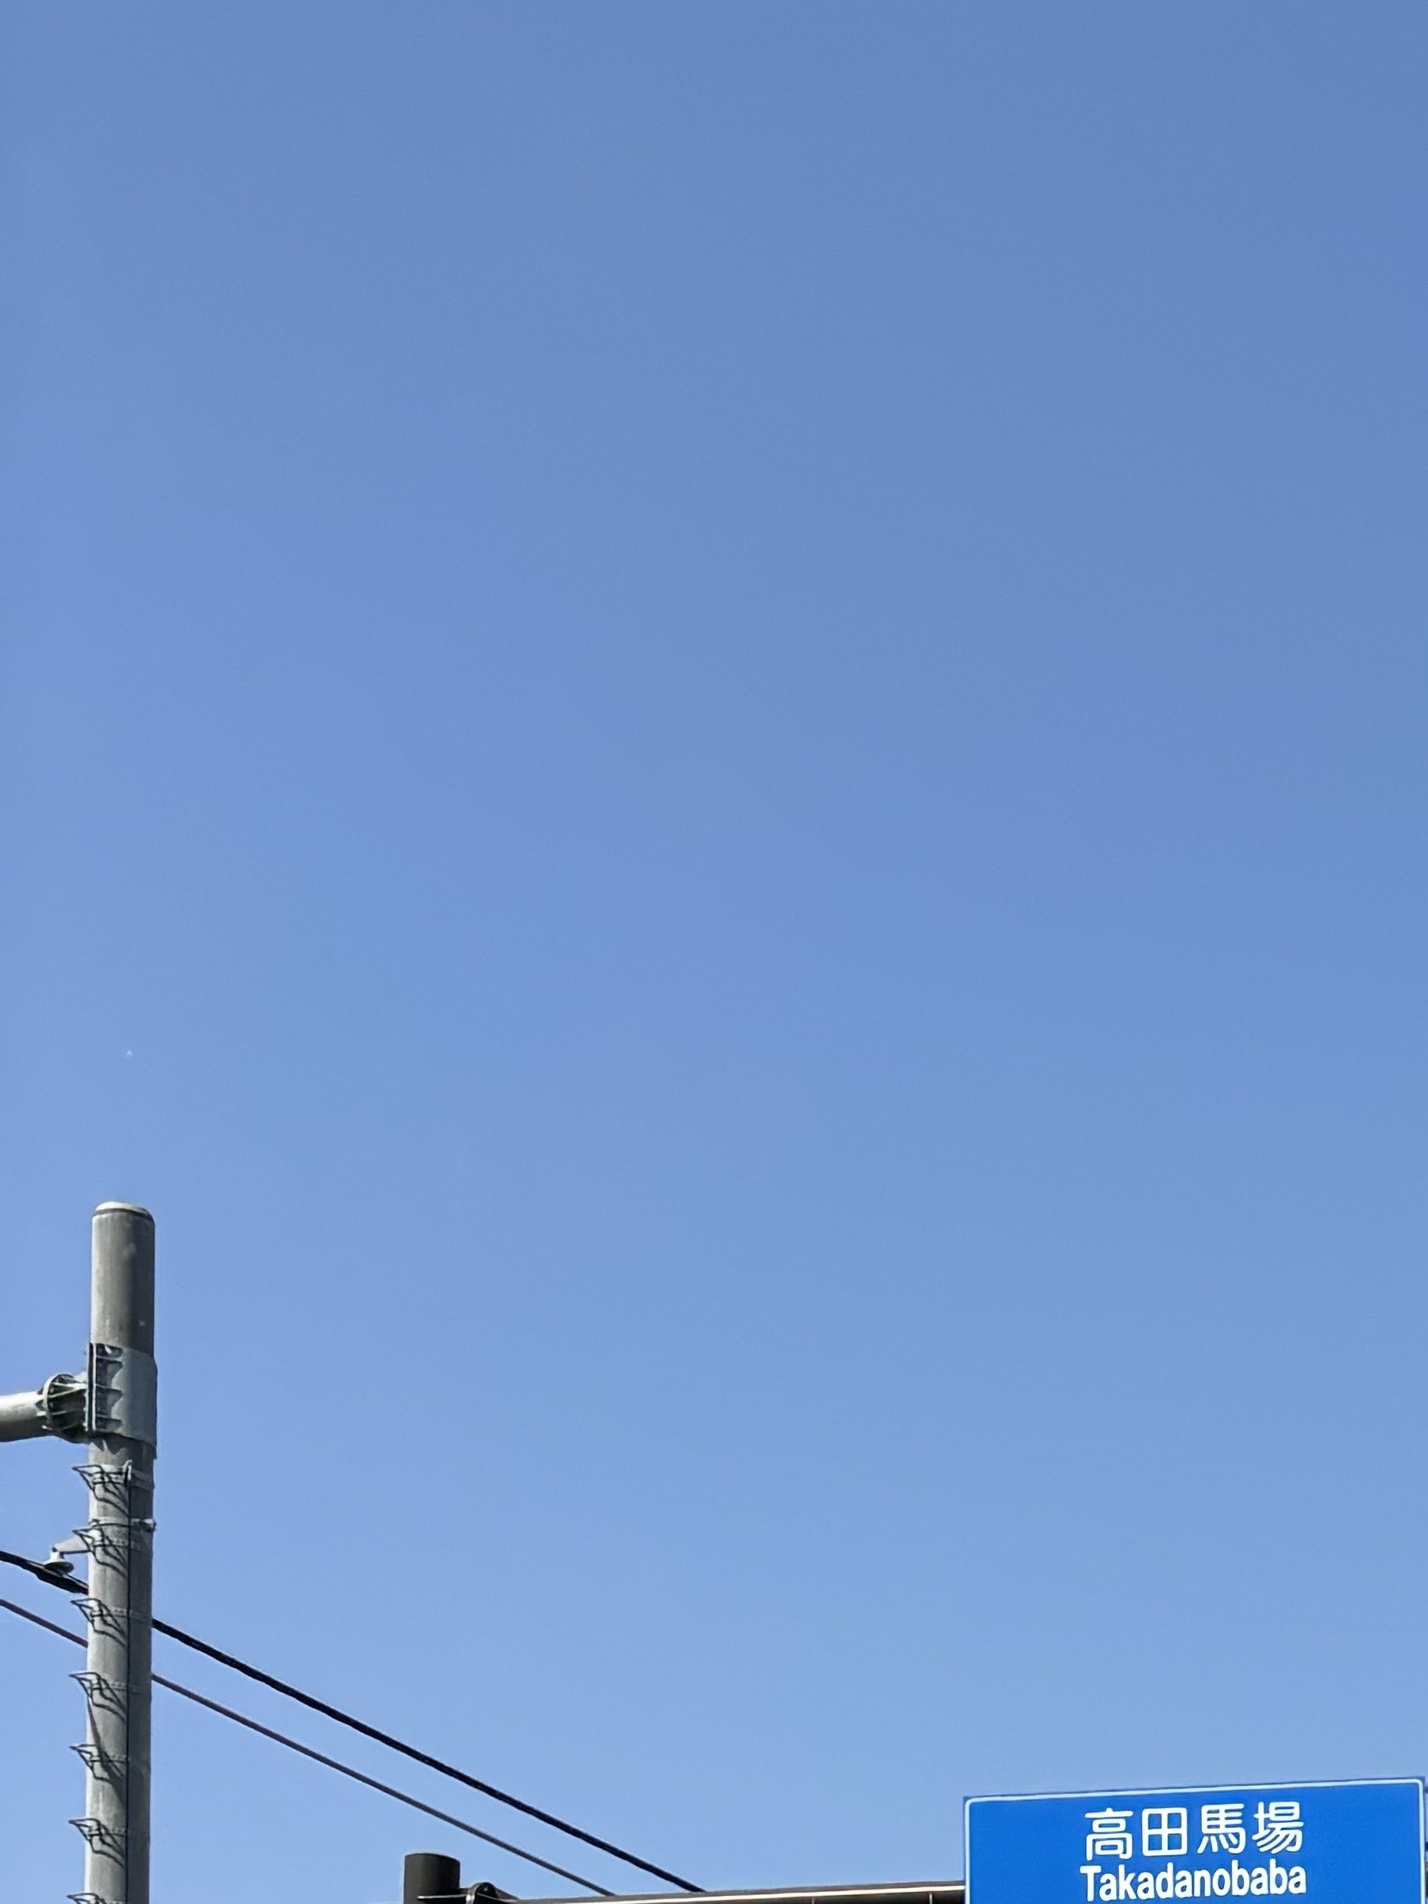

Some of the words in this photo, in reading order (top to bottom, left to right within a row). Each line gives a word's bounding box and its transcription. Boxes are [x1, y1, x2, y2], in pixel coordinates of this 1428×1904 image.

[1084, 1801, 1305, 1861] 高田馬場
[1079, 1858, 1307, 1902] Takadanobaba
